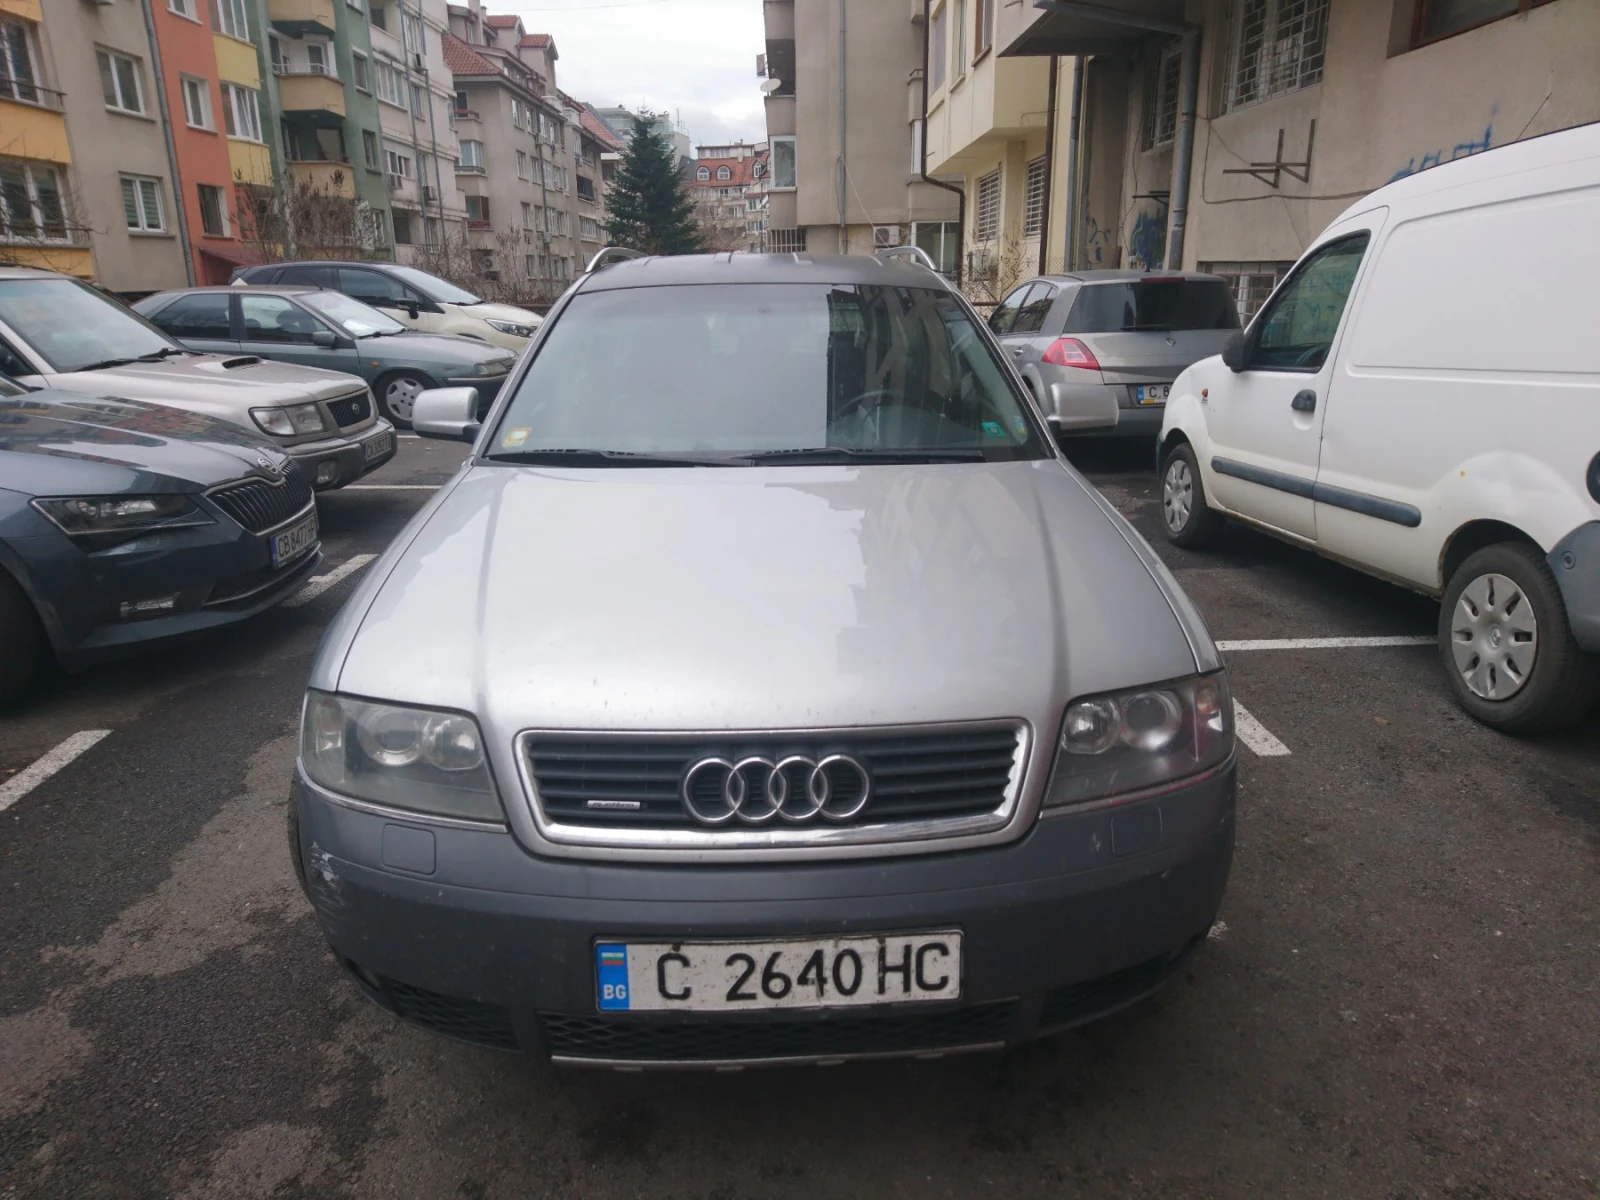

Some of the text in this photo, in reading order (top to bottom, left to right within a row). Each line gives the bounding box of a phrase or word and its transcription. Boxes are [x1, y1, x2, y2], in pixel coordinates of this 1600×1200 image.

[1149, 386, 1157, 398] C
[277, 535, 290, 557] CB
[657, 942, 950, 1002] C 2640 HC
[603, 984, 626, 1000] BG
